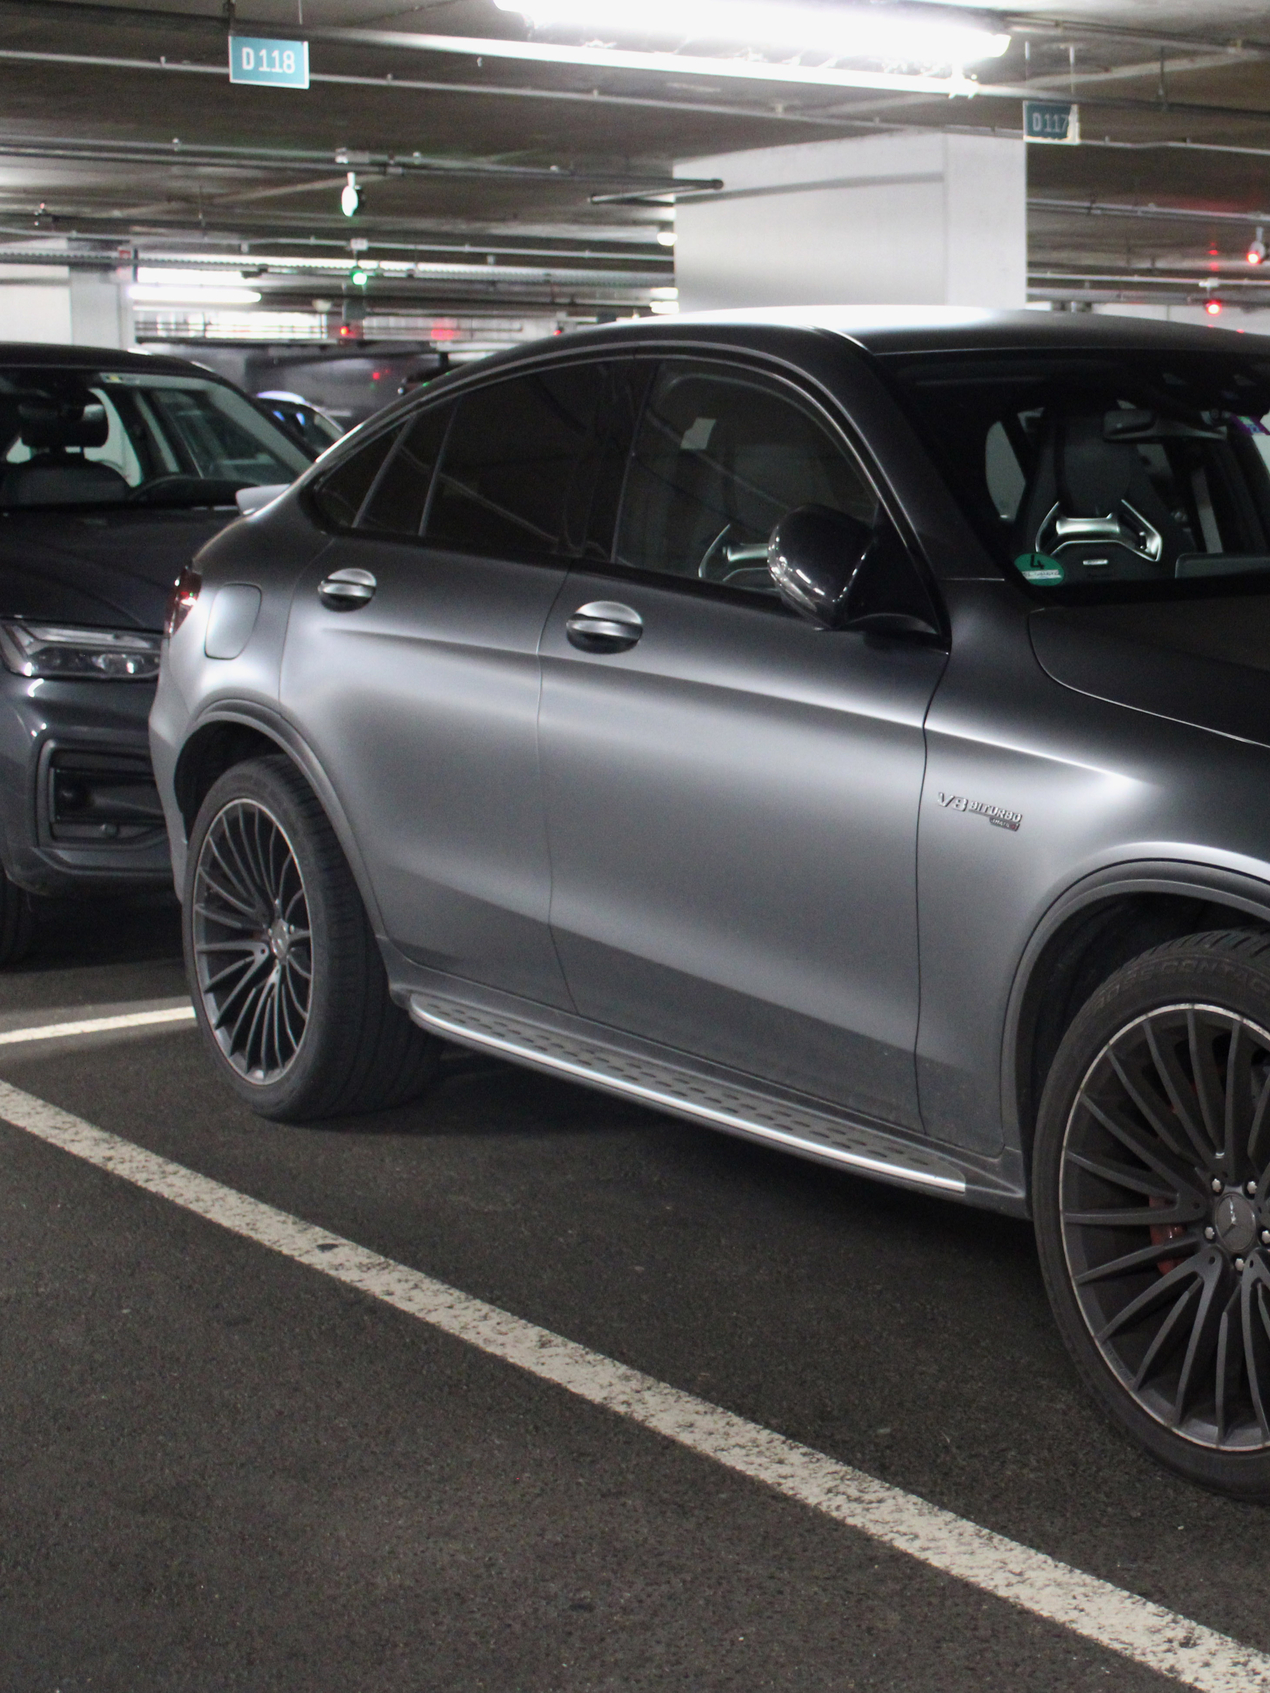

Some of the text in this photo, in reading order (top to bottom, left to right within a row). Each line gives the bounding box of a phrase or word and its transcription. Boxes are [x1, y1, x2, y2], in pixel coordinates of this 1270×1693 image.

[241, 46, 296, 74] D 118
[1044, 113, 1070, 133] 117
[1030, 554, 1045, 569] 4
[938, 792, 1023, 823] V8 BITURBO
